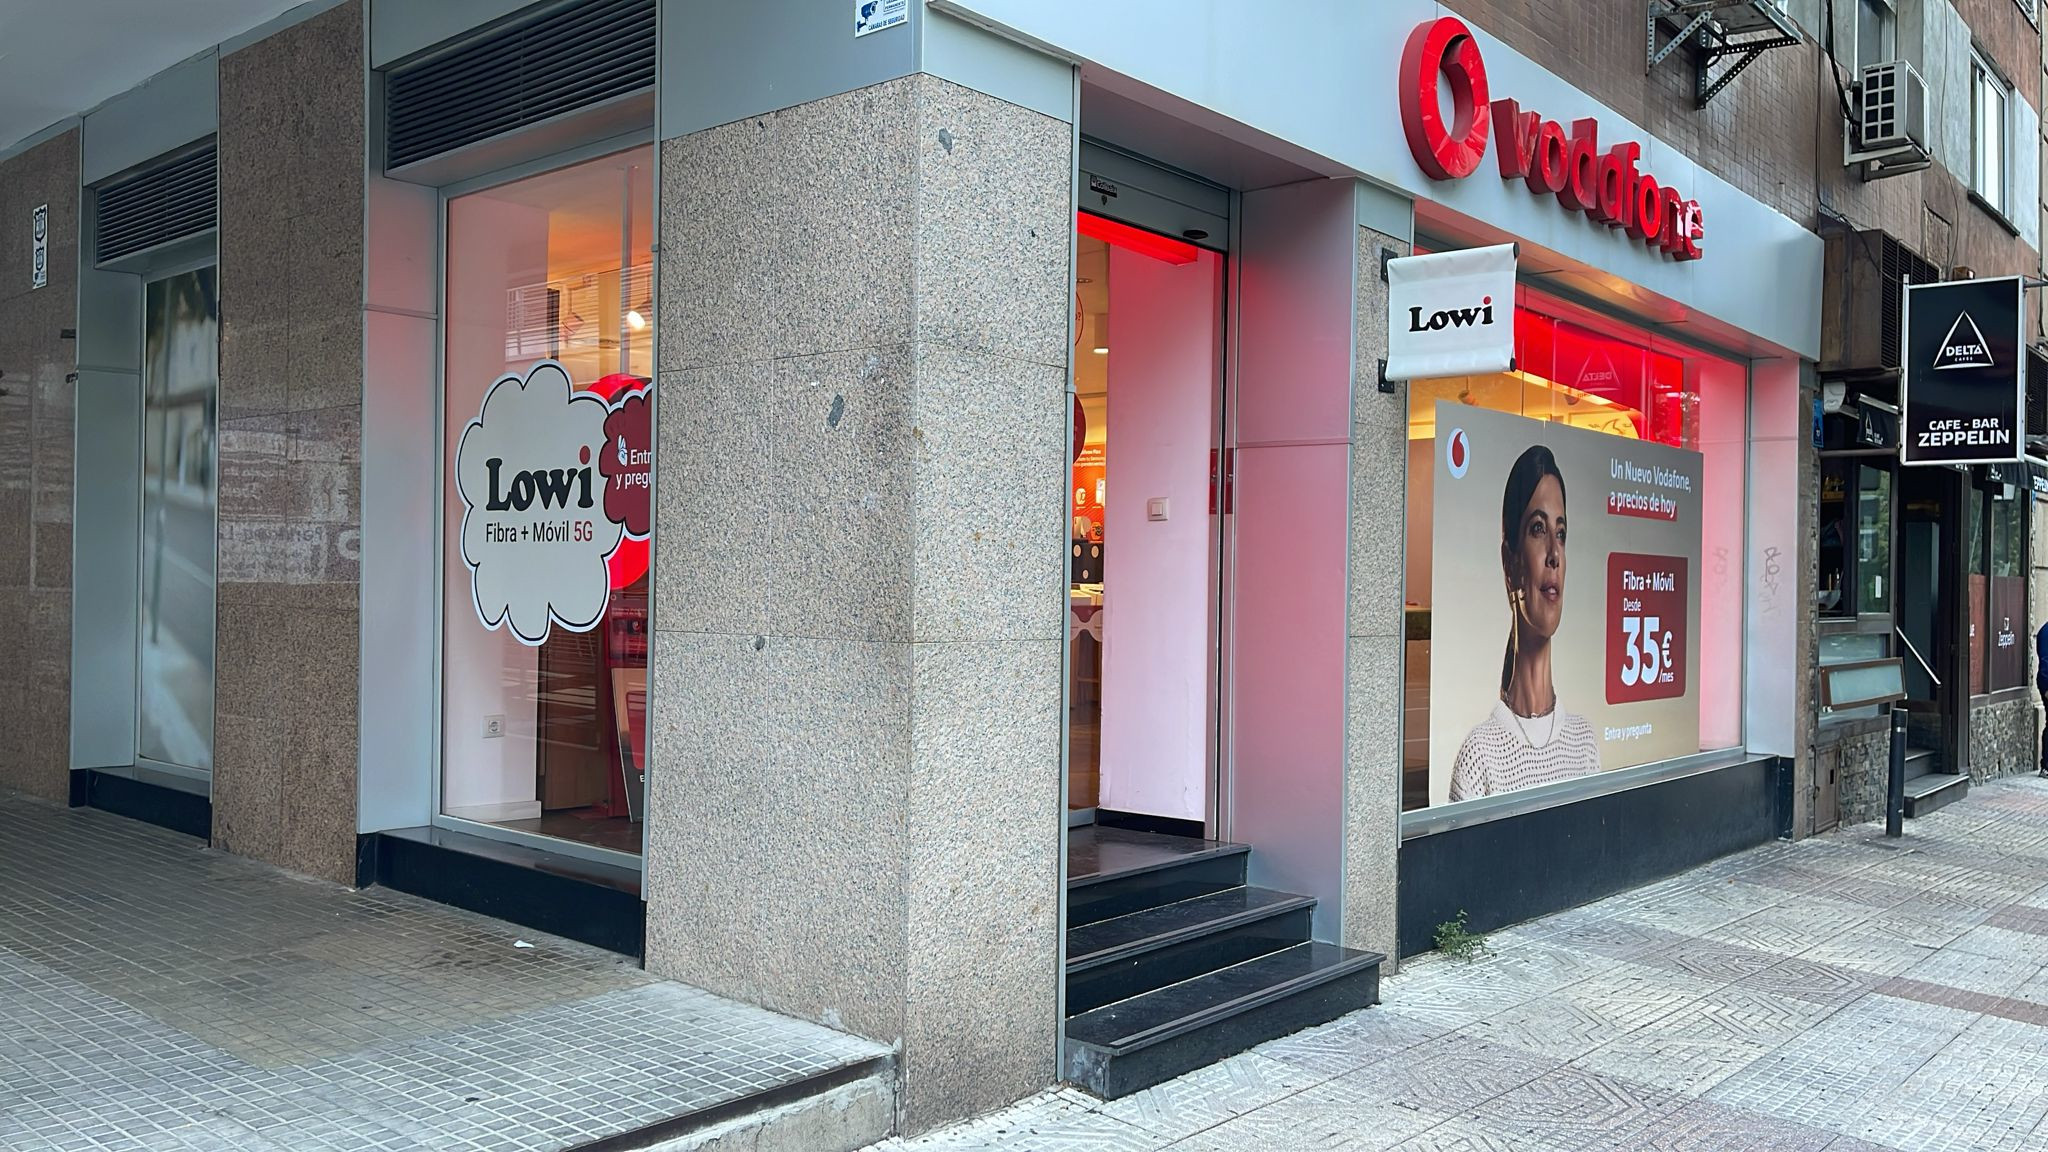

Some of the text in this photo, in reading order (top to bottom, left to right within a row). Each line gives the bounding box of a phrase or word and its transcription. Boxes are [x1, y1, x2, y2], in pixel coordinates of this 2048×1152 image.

[1490, 97, 1704, 261] vodafone
[1408, 296, 1495, 332] Lowi
[1946, 345, 1983, 357] DELTA
[1929, 420, 1961, 431] CAFE
[1972, 418, 1999, 429] BAR
[1918, 429, 2010, 447] ZEPPELIN
[485, 445, 594, 512] Lowi
[616, 473, 623, 490] y
[1610, 458, 1691, 493] Un Nuevo Vodafone,
[1610, 490, 1676, 518] a precios de hoy
[486, 520, 593, 542] Fibra + Móvil 5G
[1623, 570, 1675, 592] Fibra + Móvil
[1623, 597, 1642, 612] Desde
[1604, 727, 1621, 741] Entra
[1626, 722, 1652, 741] pregunta
